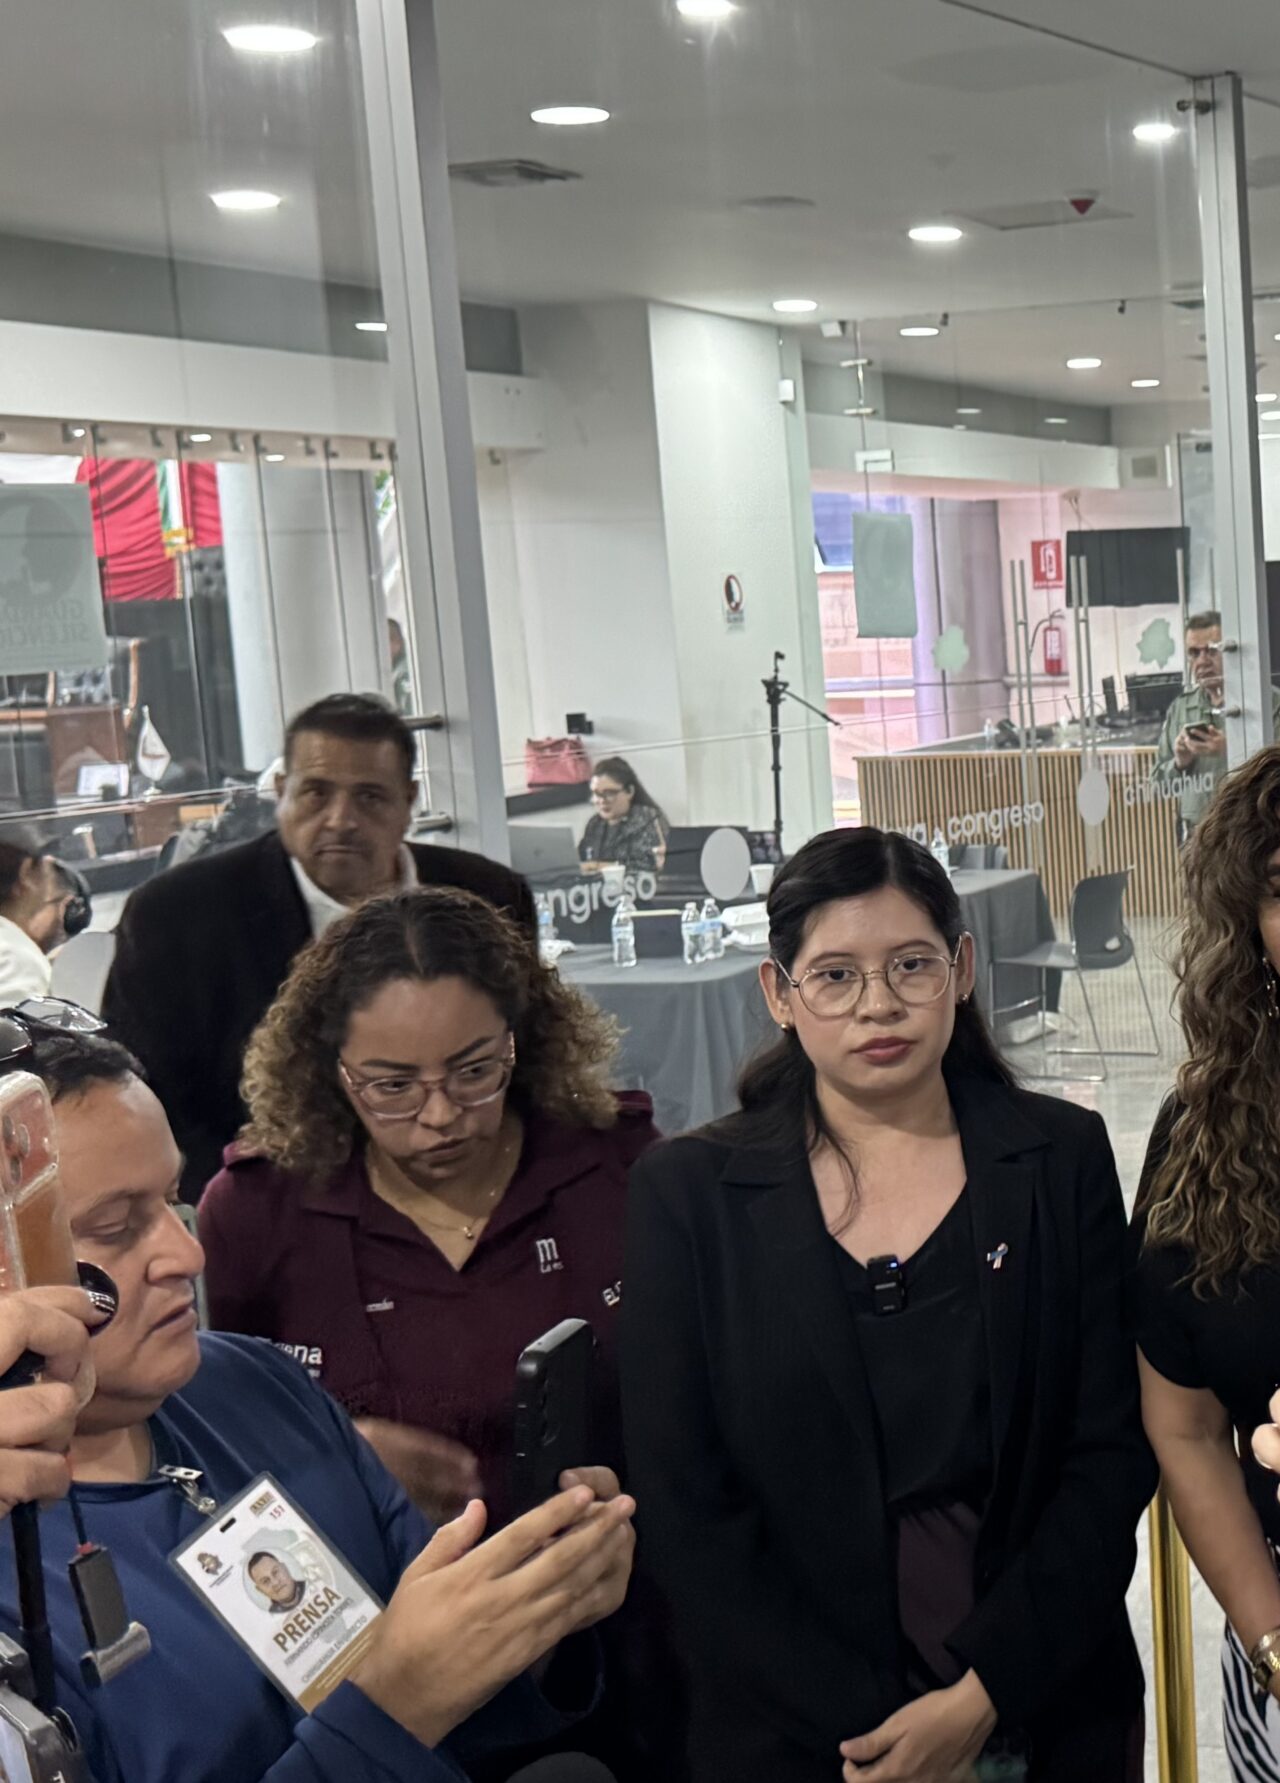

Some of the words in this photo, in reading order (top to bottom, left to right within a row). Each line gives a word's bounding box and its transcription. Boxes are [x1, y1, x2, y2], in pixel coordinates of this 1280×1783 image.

[947, 801, 1044, 840] congreso
[534, 870, 657, 924] ngreso
[536, 1238, 559, 1263] m
[269, 1504, 286, 1519] 151
[273, 1586, 341, 1653] PRENSA
